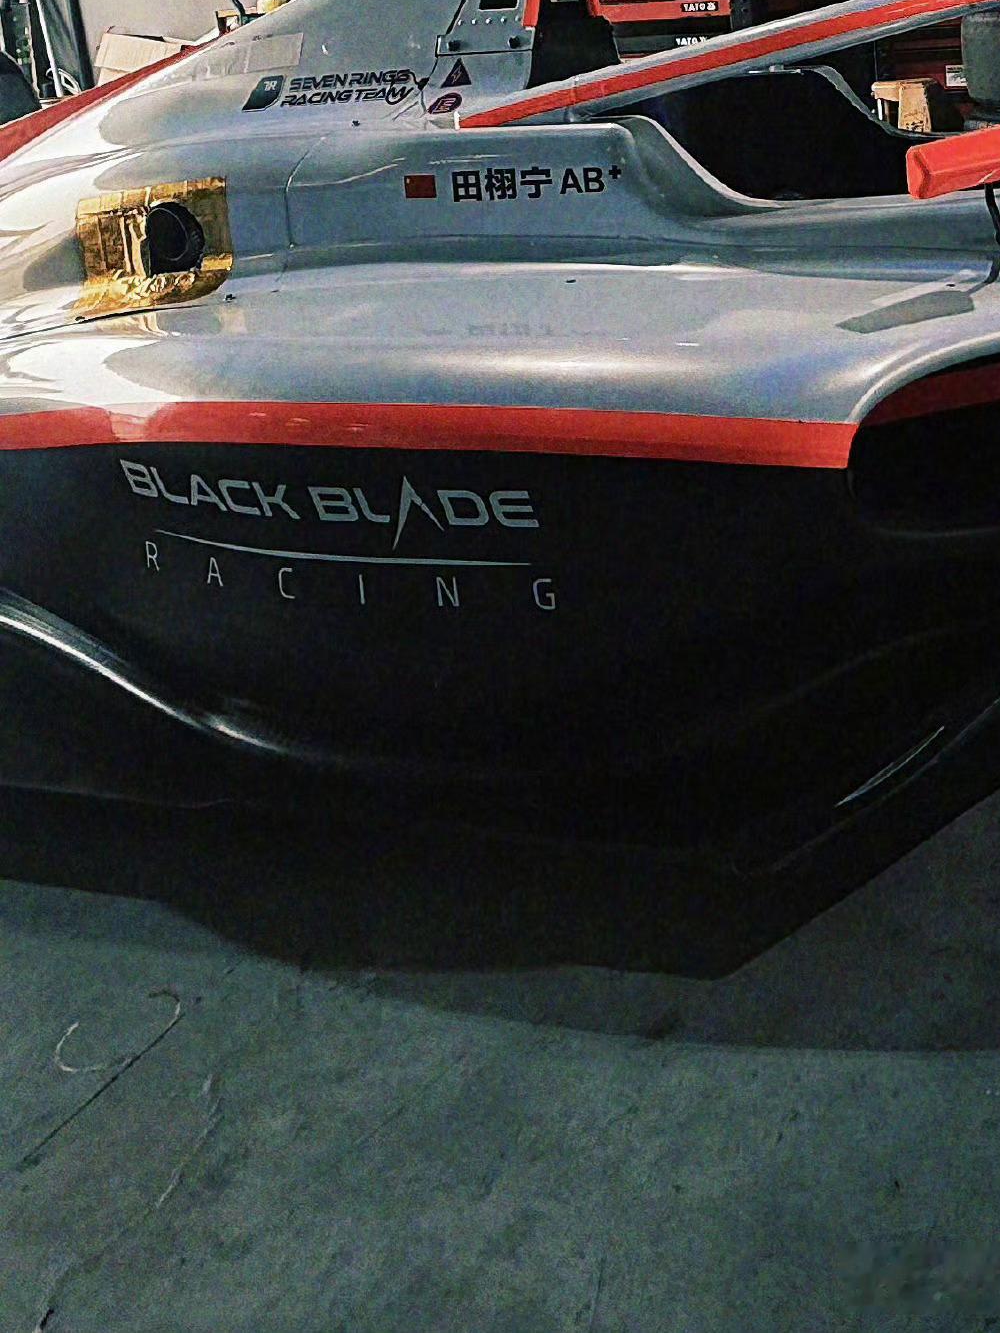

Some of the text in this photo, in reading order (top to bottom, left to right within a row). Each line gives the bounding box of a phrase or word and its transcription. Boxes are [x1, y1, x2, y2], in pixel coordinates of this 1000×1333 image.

[280, 86, 414, 108] RACING TEAM
[289, 68, 410, 92] SEVEN RINGS
[451, 166, 553, 202] 田栩宁
[119, 458, 540, 550] BLACK BLADE
[144, 540, 557, 610] RACING
